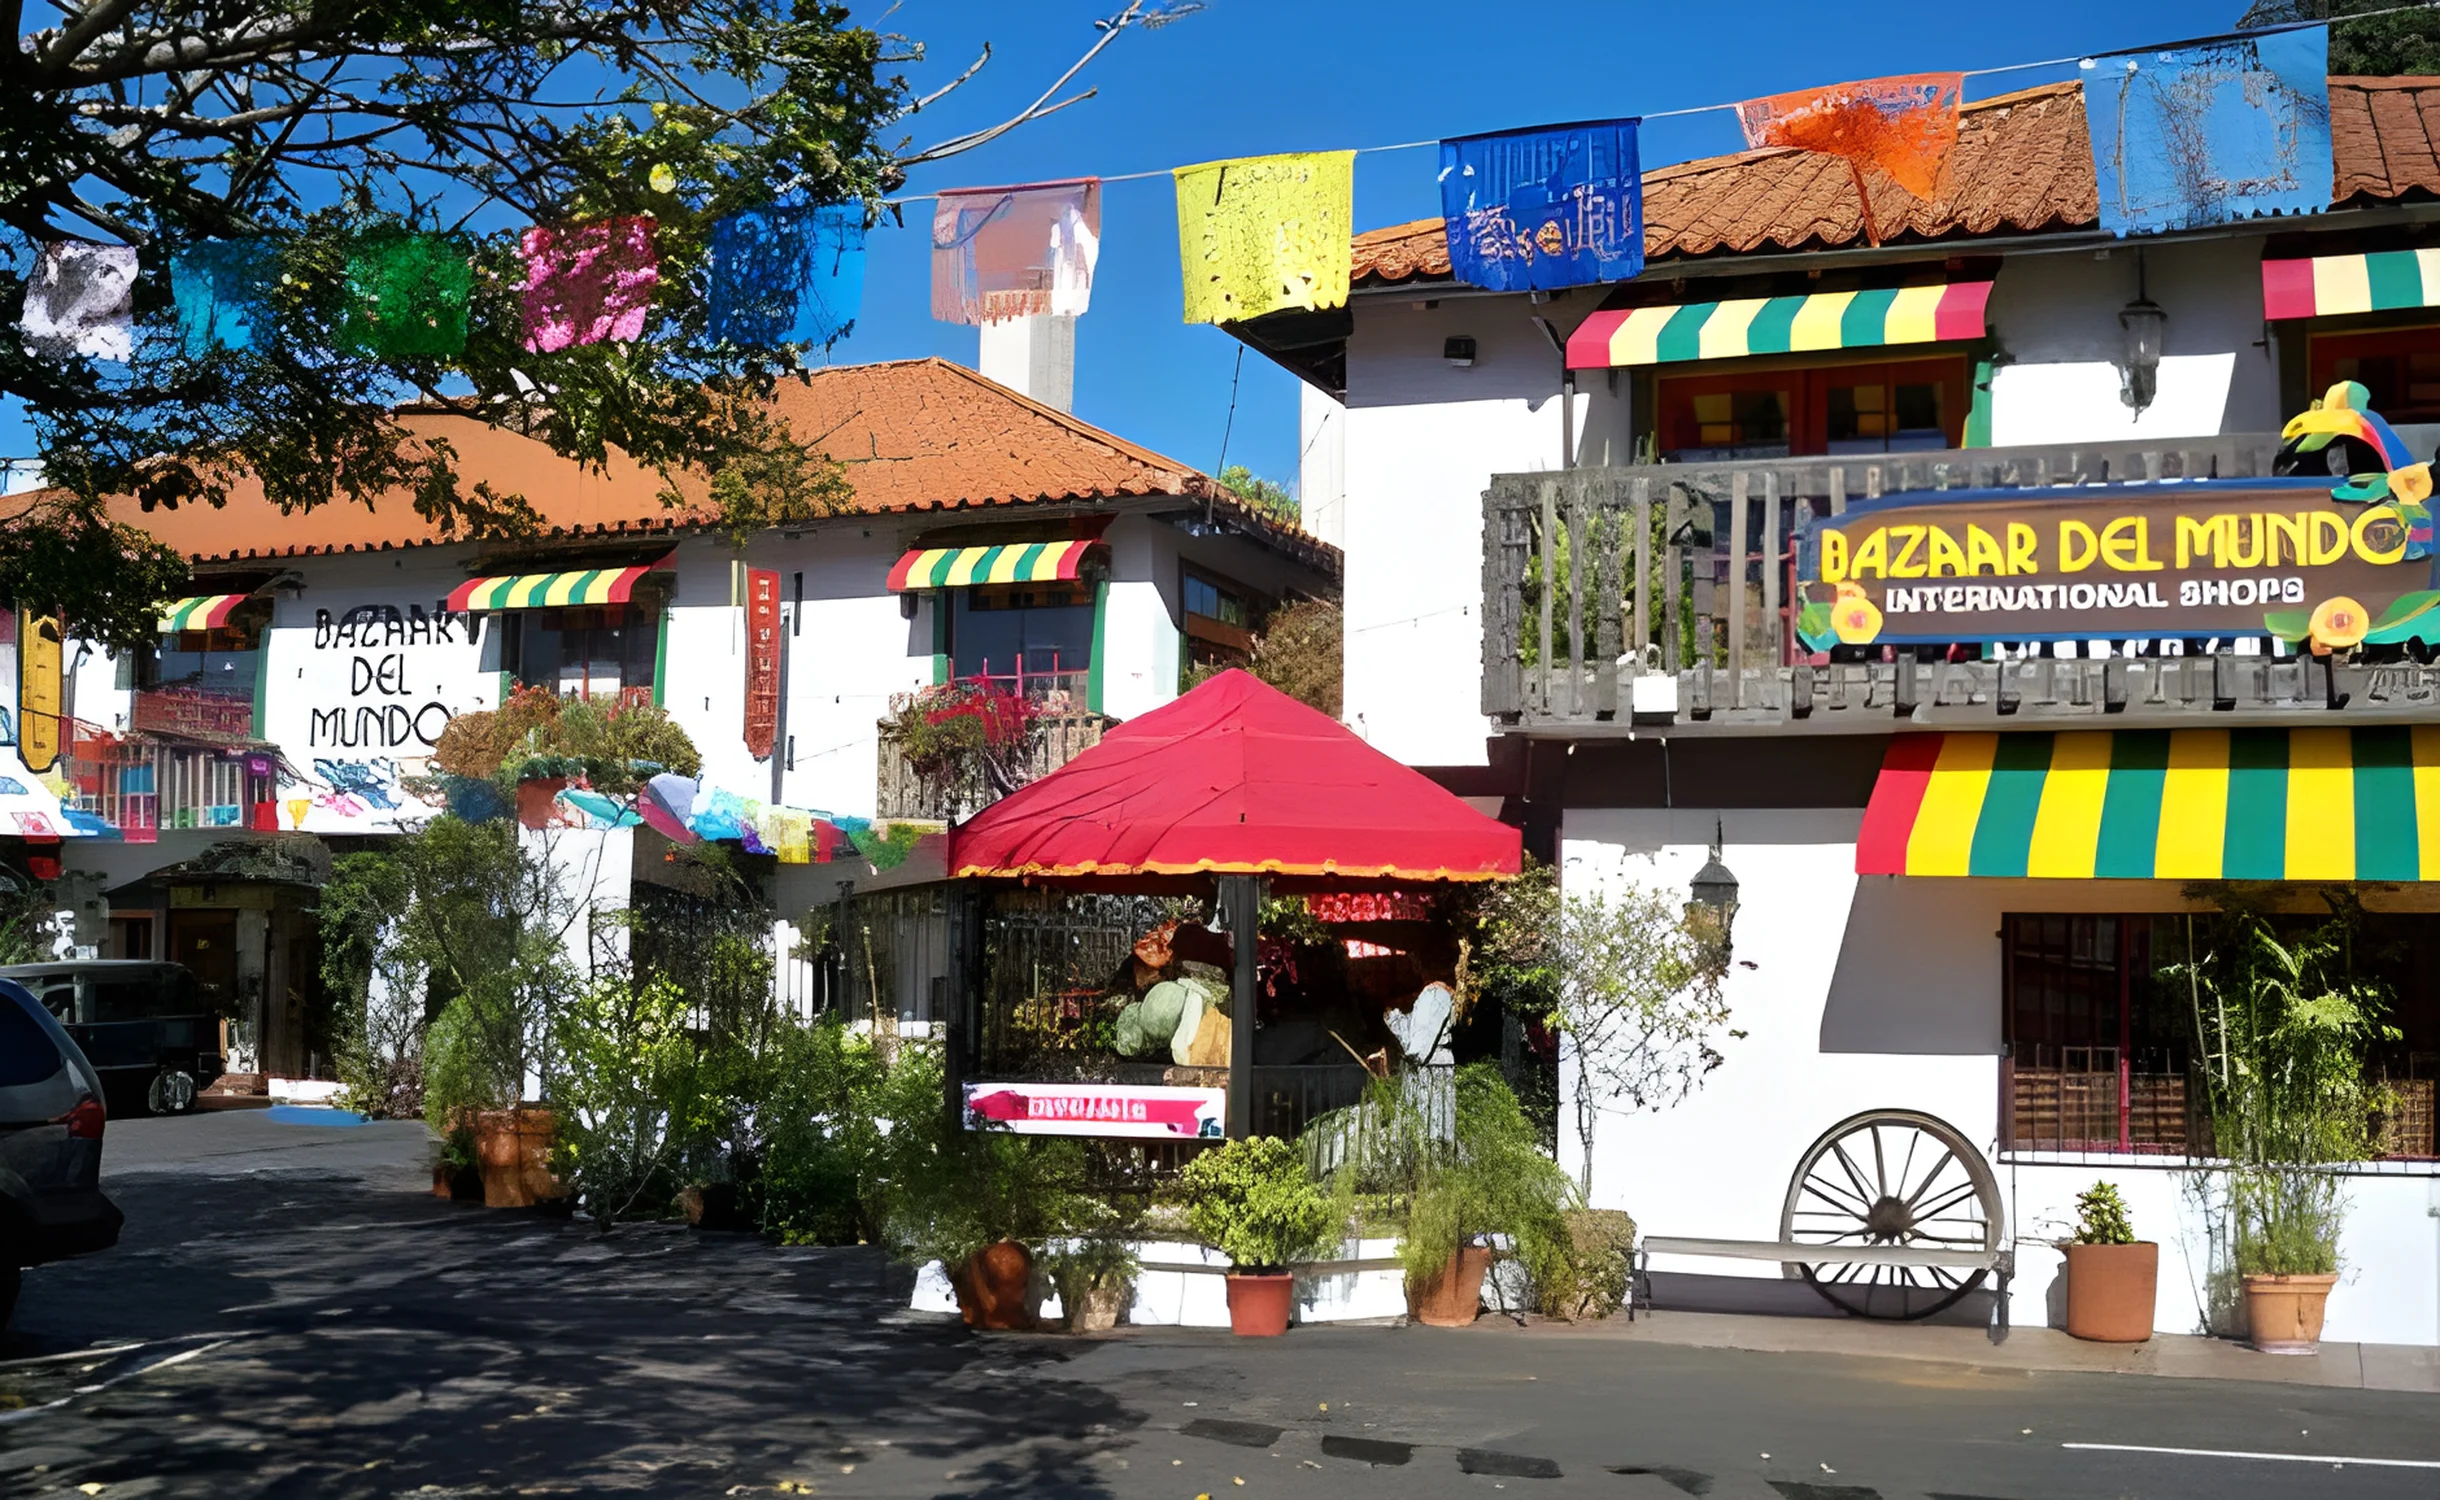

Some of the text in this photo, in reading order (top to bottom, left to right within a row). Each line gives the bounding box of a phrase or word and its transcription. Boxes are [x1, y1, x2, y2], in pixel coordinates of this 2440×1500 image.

[1821, 505, 2408, 583] BAZAAR DEL MUNDO
[1886, 577, 2305, 613] INTERNATIONAL SHOPS
[351, 653, 412, 696] DEL
[310, 701, 452, 747] MUNDO
